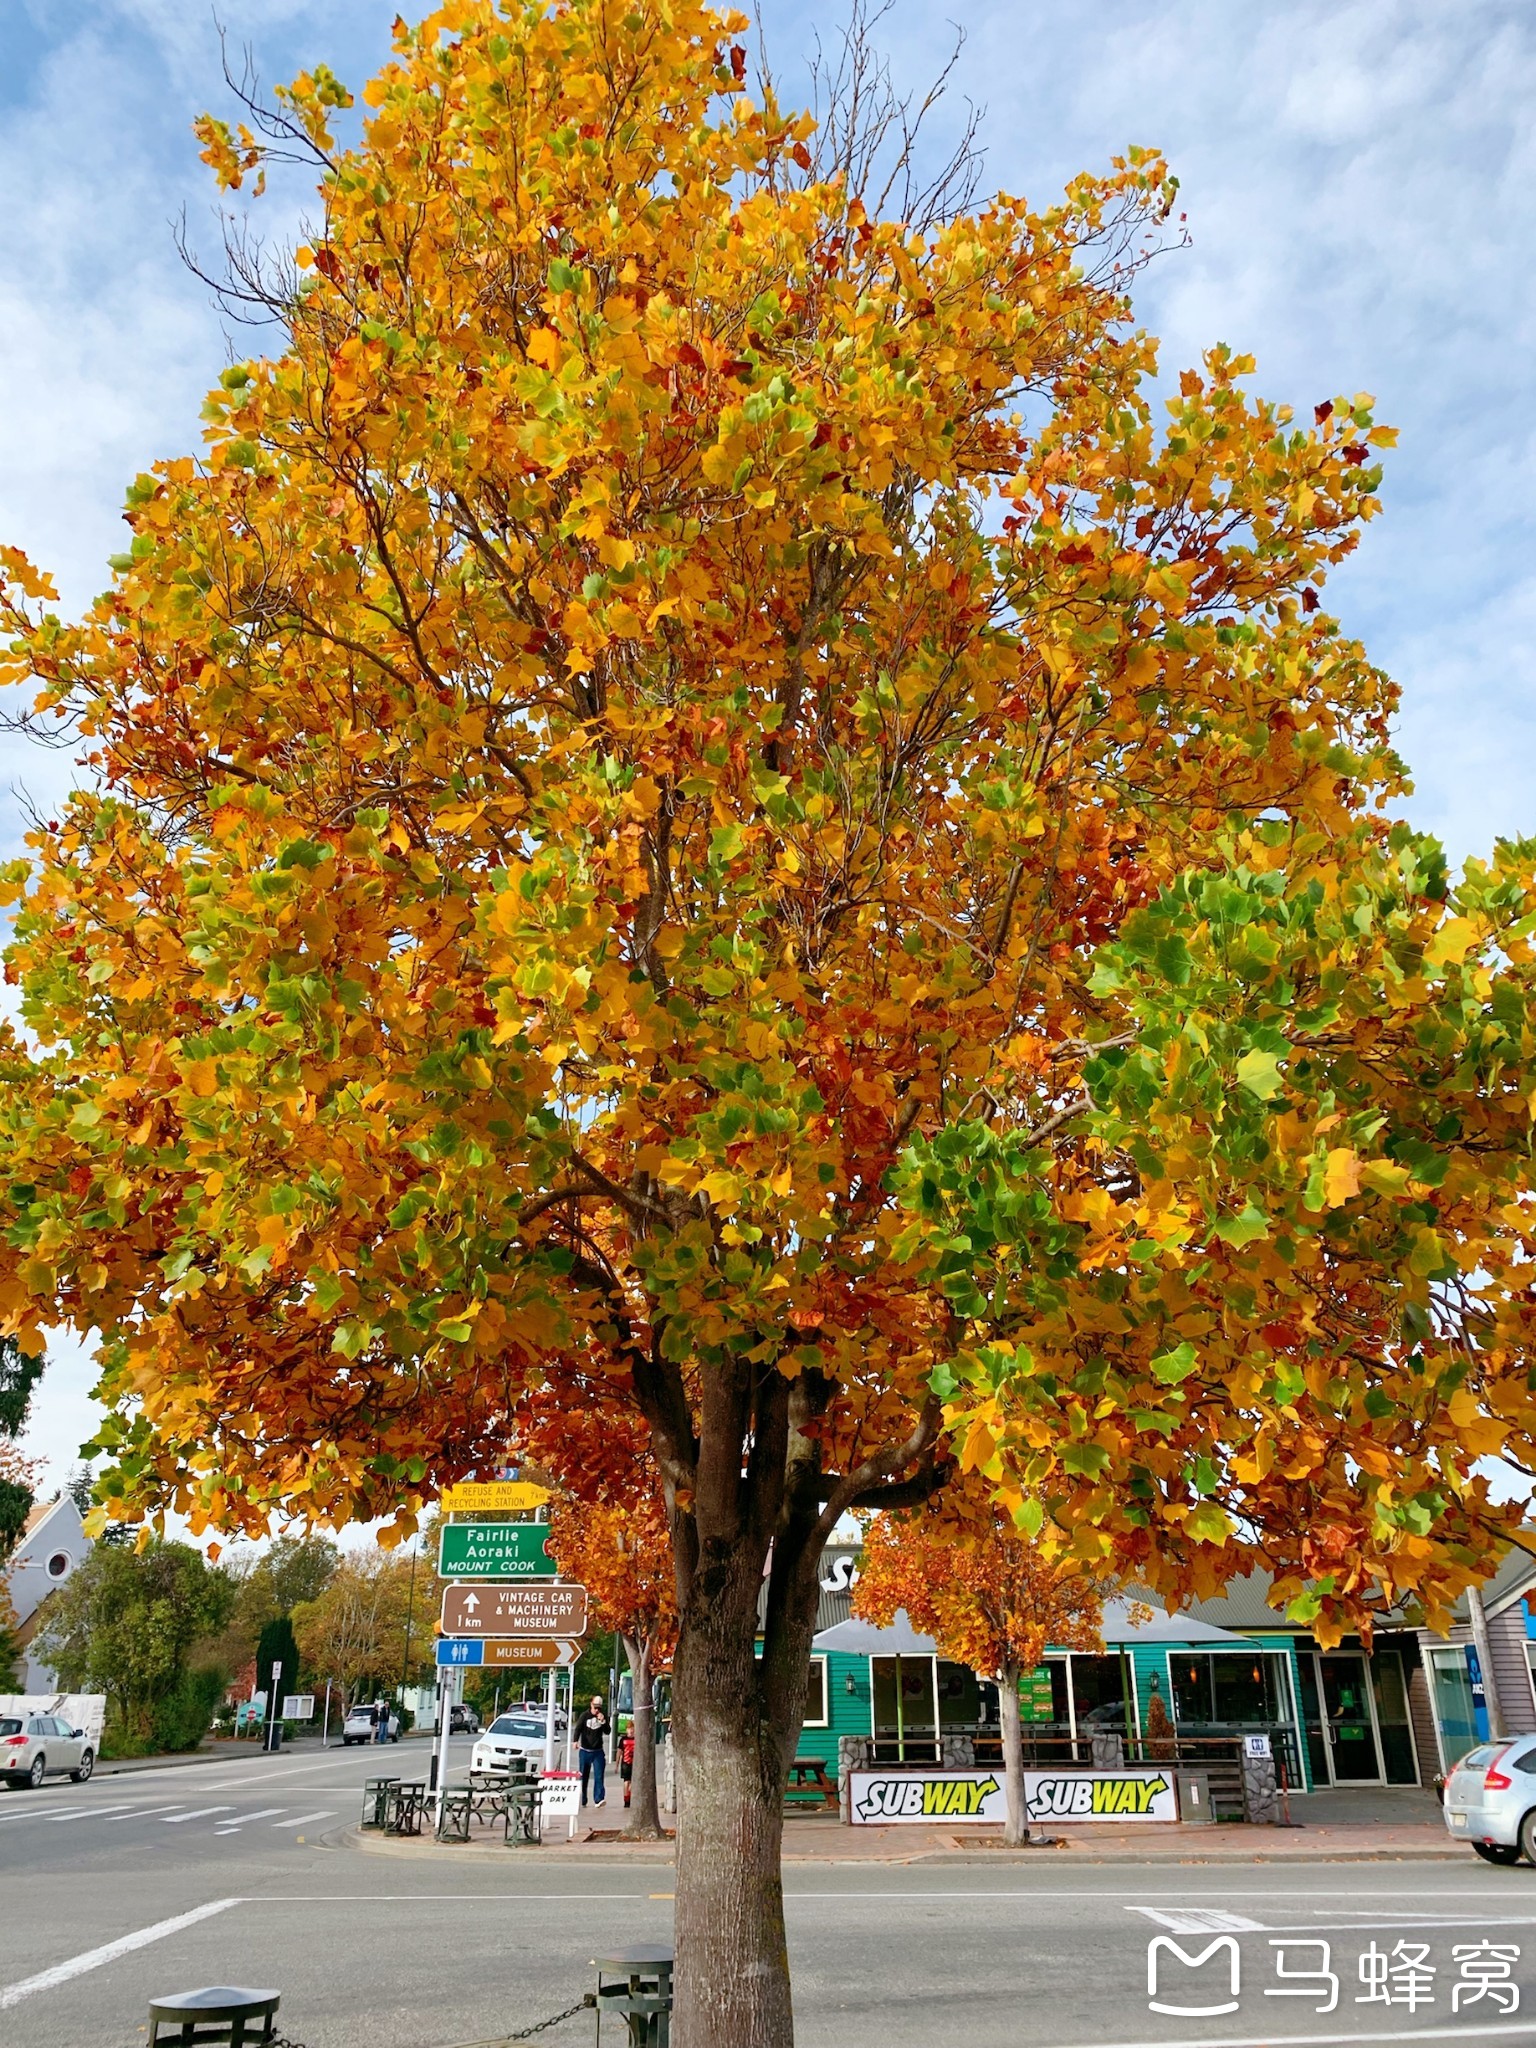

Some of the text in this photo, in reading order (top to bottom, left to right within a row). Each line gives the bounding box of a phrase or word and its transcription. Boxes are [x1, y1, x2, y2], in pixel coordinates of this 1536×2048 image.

[463, 1486, 512, 1496] REFUSE AND
[449, 1498, 525, 1508] RECYCLING STATION
[467, 1530, 519, 1541] Fairlie
[466, 1545, 519, 1558] Aoraki
[447, 1561, 536, 1571] MOUNT COOK
[499, 1592, 573, 1603] VINTAGE CAR
[496, 1605, 574, 1615] & MACHINERY
[458, 1614, 482, 1627] 1 km
[514, 1618, 557, 1627] MUSEUM
[496, 1648, 543, 1658] MUSEUM
[856, 1774, 1000, 1821] SUBWAY
[1027, 1773, 1169, 1820] SUBWAY
